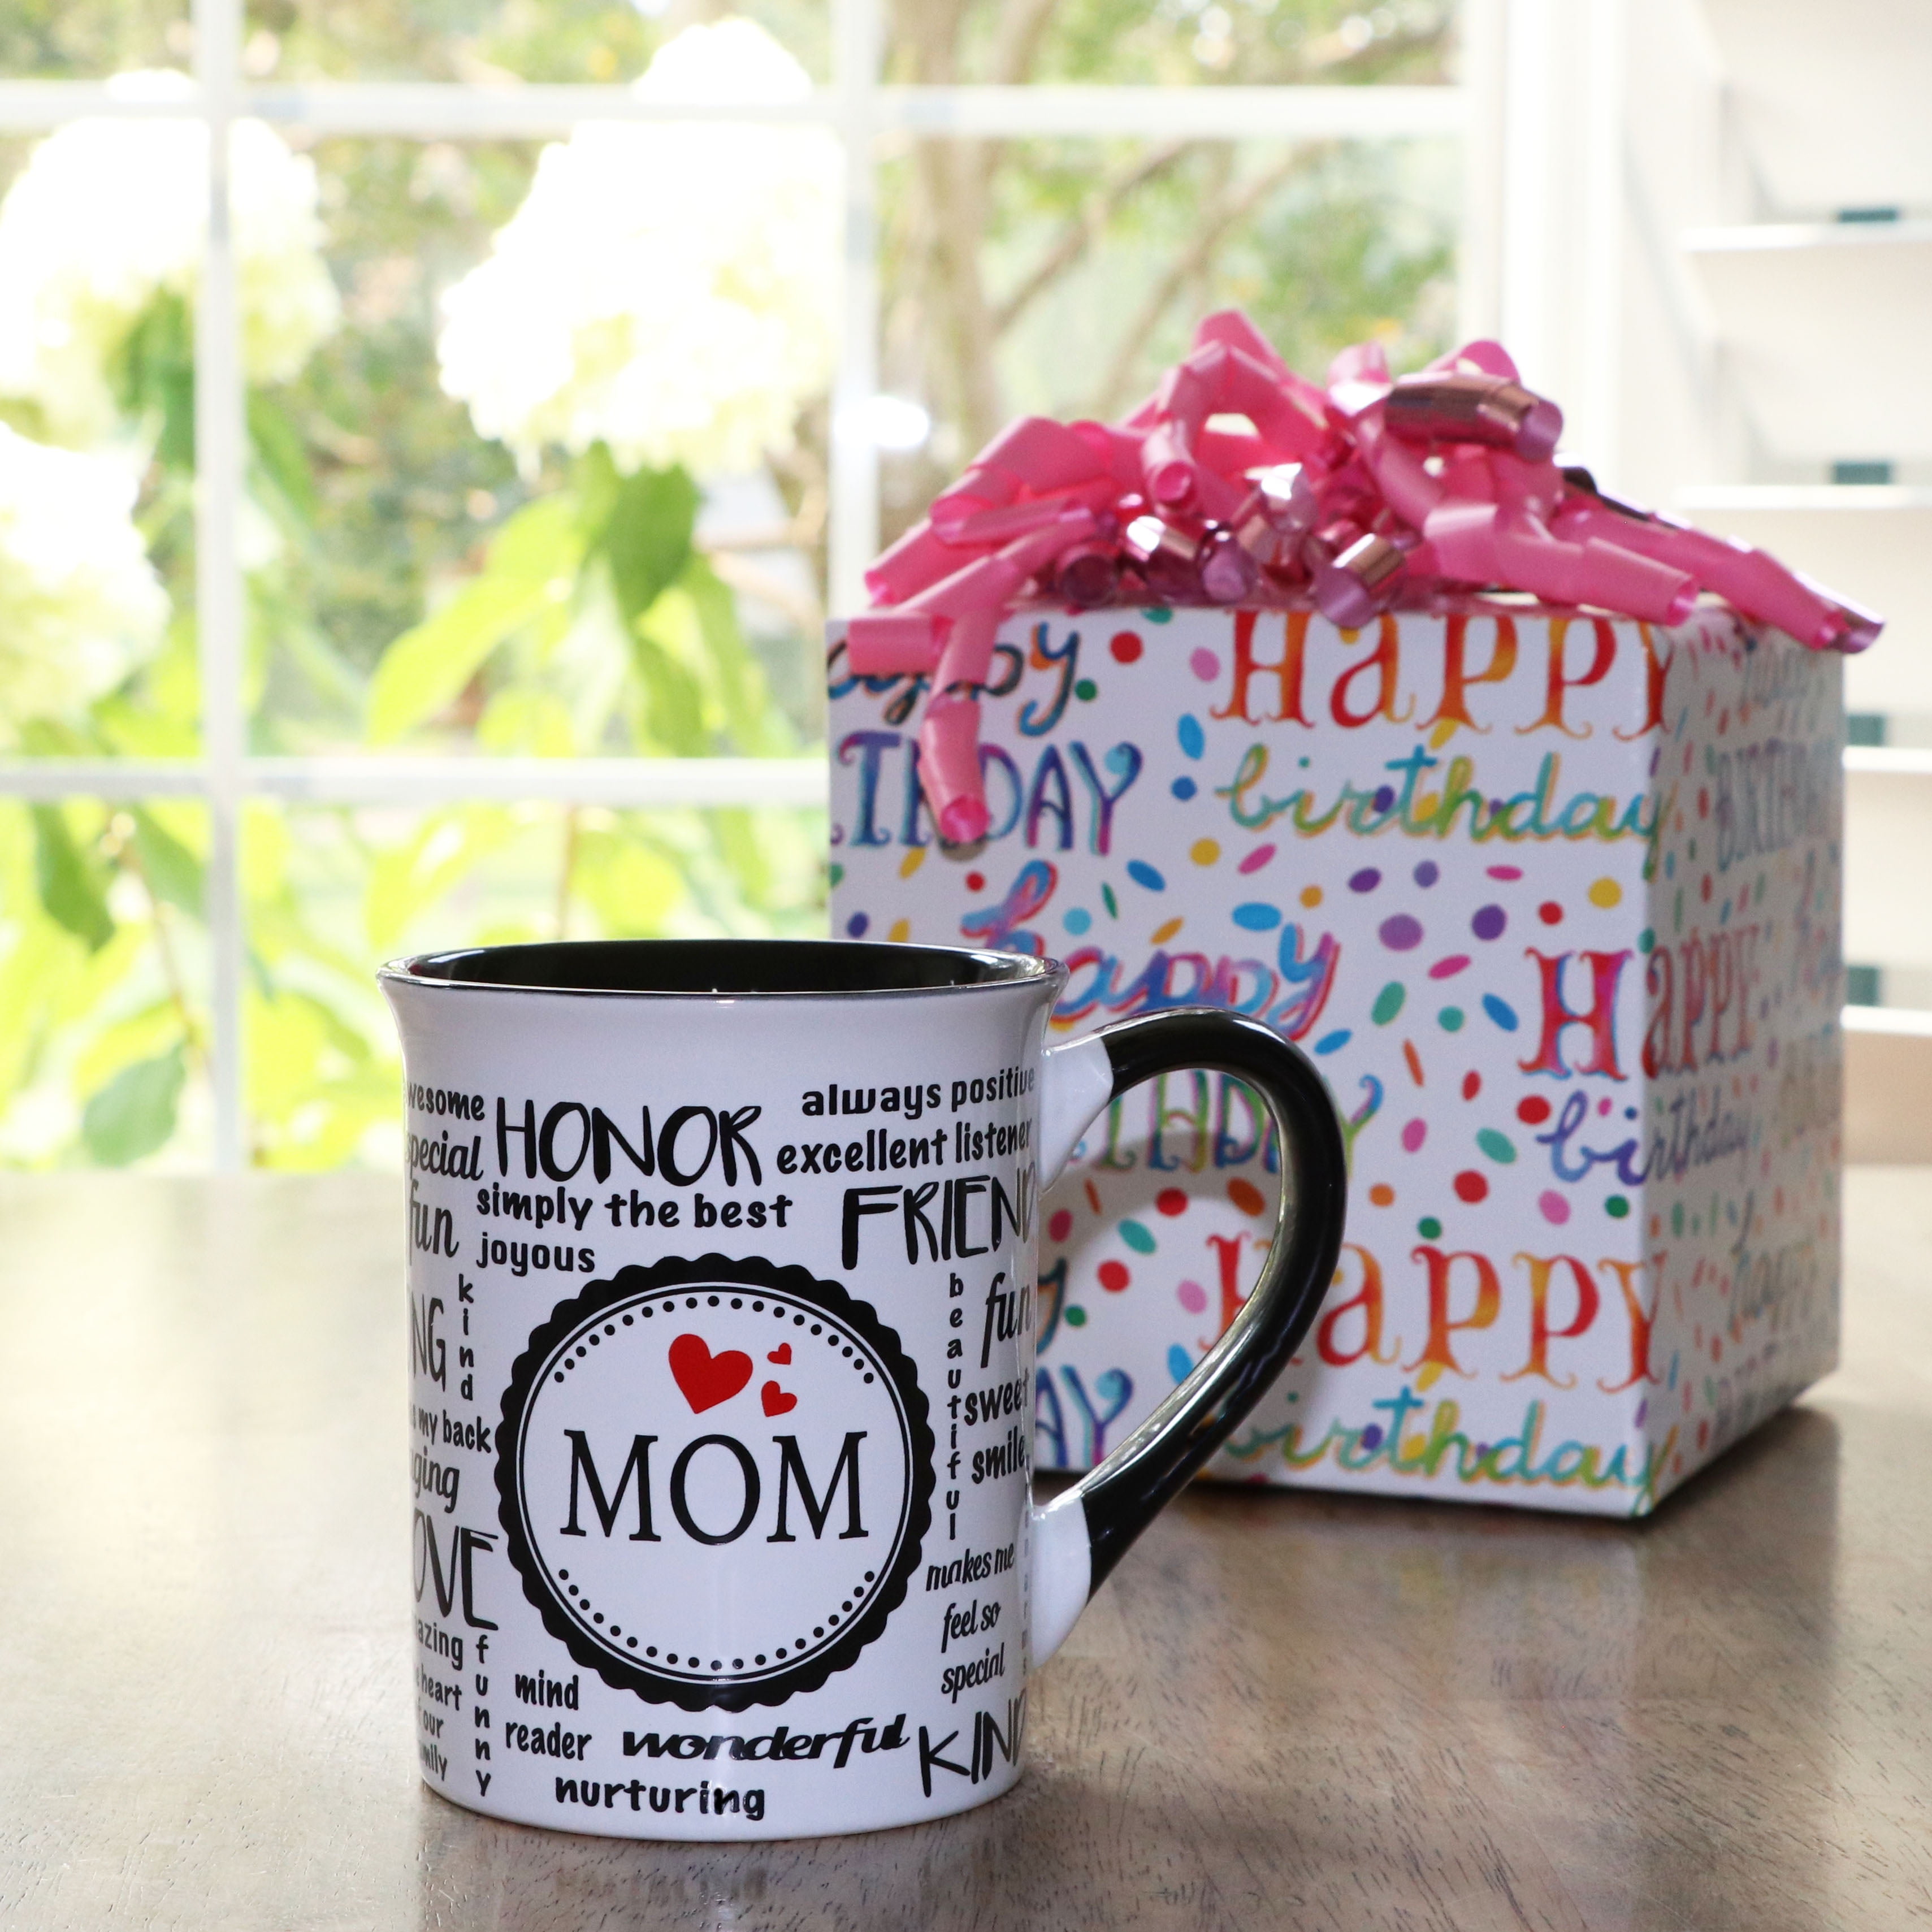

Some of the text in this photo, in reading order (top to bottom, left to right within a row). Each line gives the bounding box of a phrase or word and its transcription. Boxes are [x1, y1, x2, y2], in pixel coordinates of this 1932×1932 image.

[1214, 743, 1679, 884] birthday
[802, 1065, 1036, 1120] always positive
[496, 1096, 762, 1187] HONOR
[777, 1117, 1033, 1175] excellent listener
[409, 1178, 460, 1266] fun
[476, 1182, 793, 1231] simply the best
[475, 1232, 595, 1277] joyous
[458, 1273, 474, 1402] kind
[980, 1272, 1032, 1368] fun
[946, 1272, 964, 1541] beautiful
[964, 1367, 1030, 1426] sweet
[418, 1406, 438, 1446] my
[443, 1409, 492, 1454] back
[971, 1426, 1026, 1484] smile
[559, 1429, 870, 1546] MOM
[925, 1542, 1015, 1592] makes me
[414, 1618, 463, 1671] azing
[941, 1599, 1002, 1653] feel so
[421, 1662, 462, 1712] heart
[514, 1669, 579, 1710] mind
[941, 1641, 1006, 1704] special
[423, 1709, 444, 1739] our
[474, 1634, 492, 1797] funny
[505, 1722, 592, 1761] reader
[622, 1713, 911, 1769] wonderful
[919, 1687, 1028, 1798] KIND
[555, 1776, 765, 1821] nurturing
